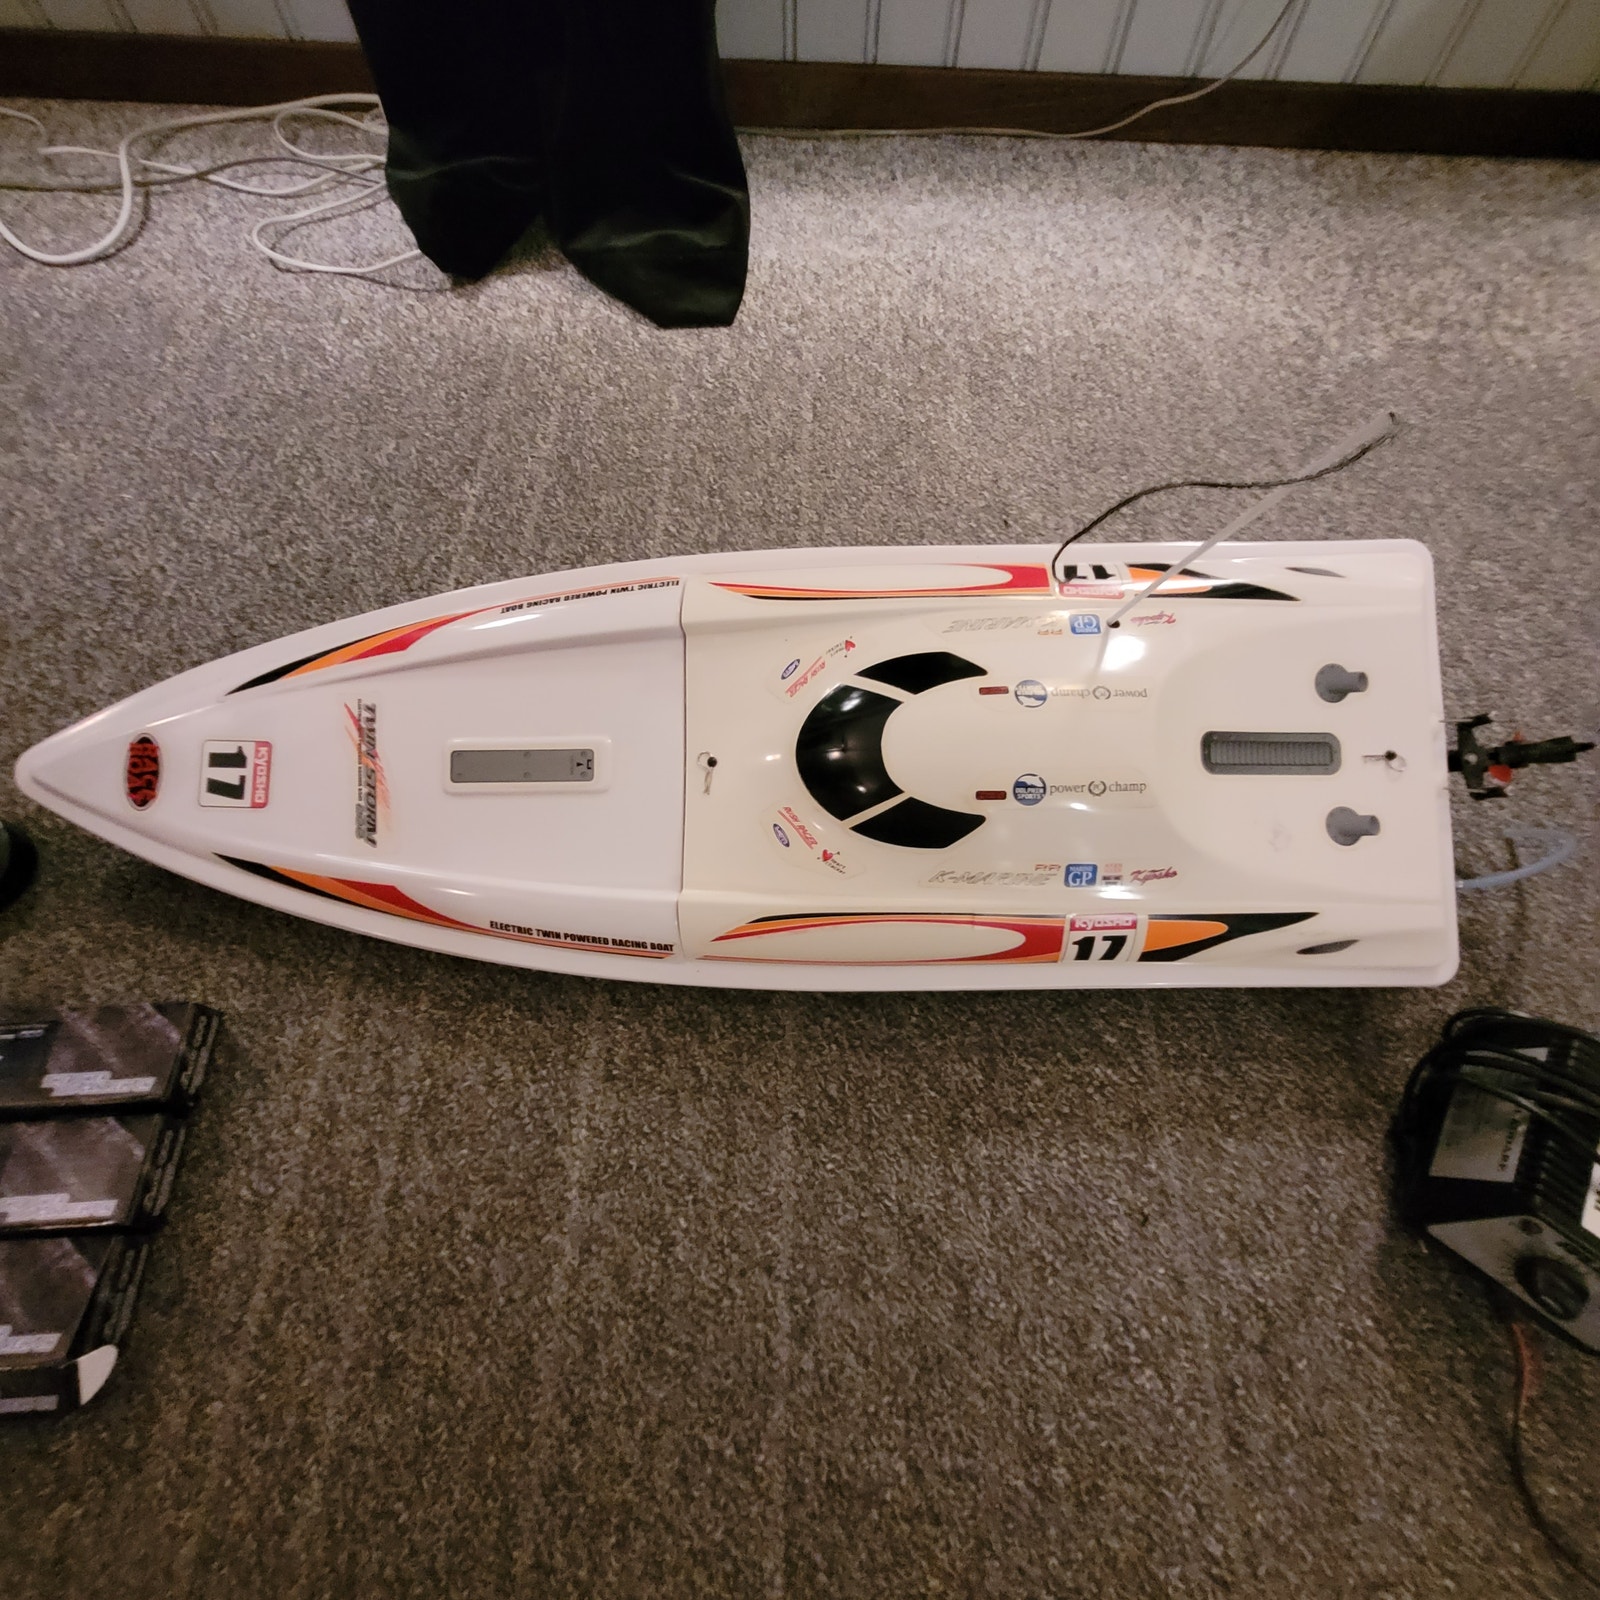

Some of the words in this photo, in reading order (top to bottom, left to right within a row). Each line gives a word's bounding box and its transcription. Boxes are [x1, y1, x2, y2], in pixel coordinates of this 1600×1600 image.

[610, 585, 635, 595] TWIN
[637, 580, 680, 591] ELECTRIC
[526, 596, 562, 608] RACING
[564, 589, 608, 602] POWERED
[500, 603, 524, 614] BOAT
[1074, 616, 1098, 628] GP
[1051, 687, 1091, 699] champ
[1113, 687, 1148, 698] power
[363, 703, 377, 760] TWIN
[206, 745, 247, 800] 17
[1050, 783, 1086, 796] power
[1108, 781, 1147, 793] champ
[364, 766, 377, 848] STORM
[1068, 871, 1093, 886] GP
[489, 920, 534, 936] ELECTRIC
[535, 928, 562, 940] TWIN
[563, 933, 610, 946] POWERED
[611, 938, 648, 949] RACING
[650, 942, 675, 952] BOAT
[1071, 935, 1128, 961] 17
